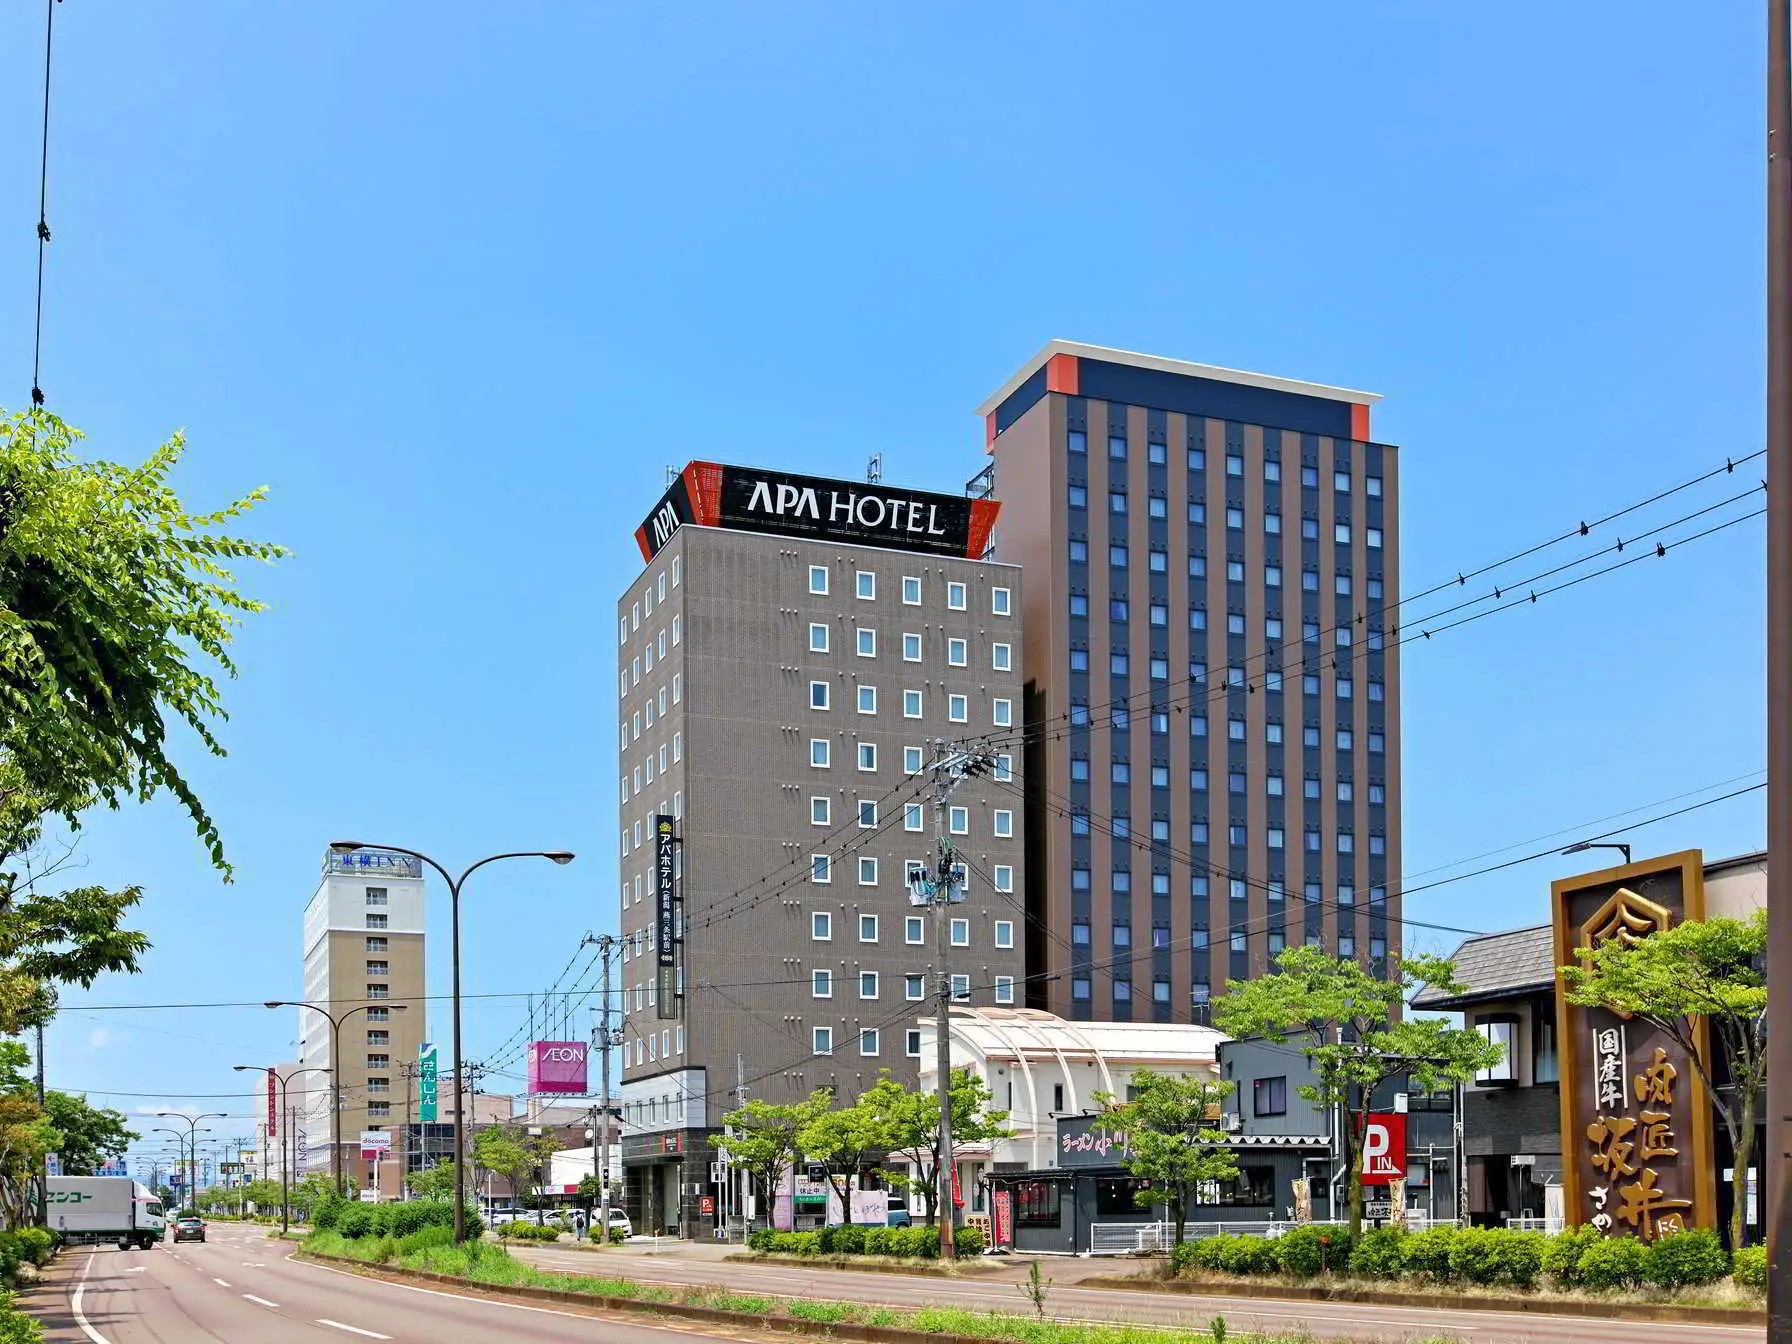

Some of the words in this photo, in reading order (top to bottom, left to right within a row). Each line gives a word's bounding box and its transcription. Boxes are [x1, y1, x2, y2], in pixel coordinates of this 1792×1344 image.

[652, 500, 680, 549] APA
[747, 481, 820, 520] APA
[828, 490, 946, 536] HOTEL
[660, 833, 672, 889] アパホテル
[421, 1059, 437, 1105] さんしん
[1598, 1027, 1623, 1109] 国産牛
[1362, 1123, 1390, 1175] P
[1376, 1156, 1393, 1171] IN
